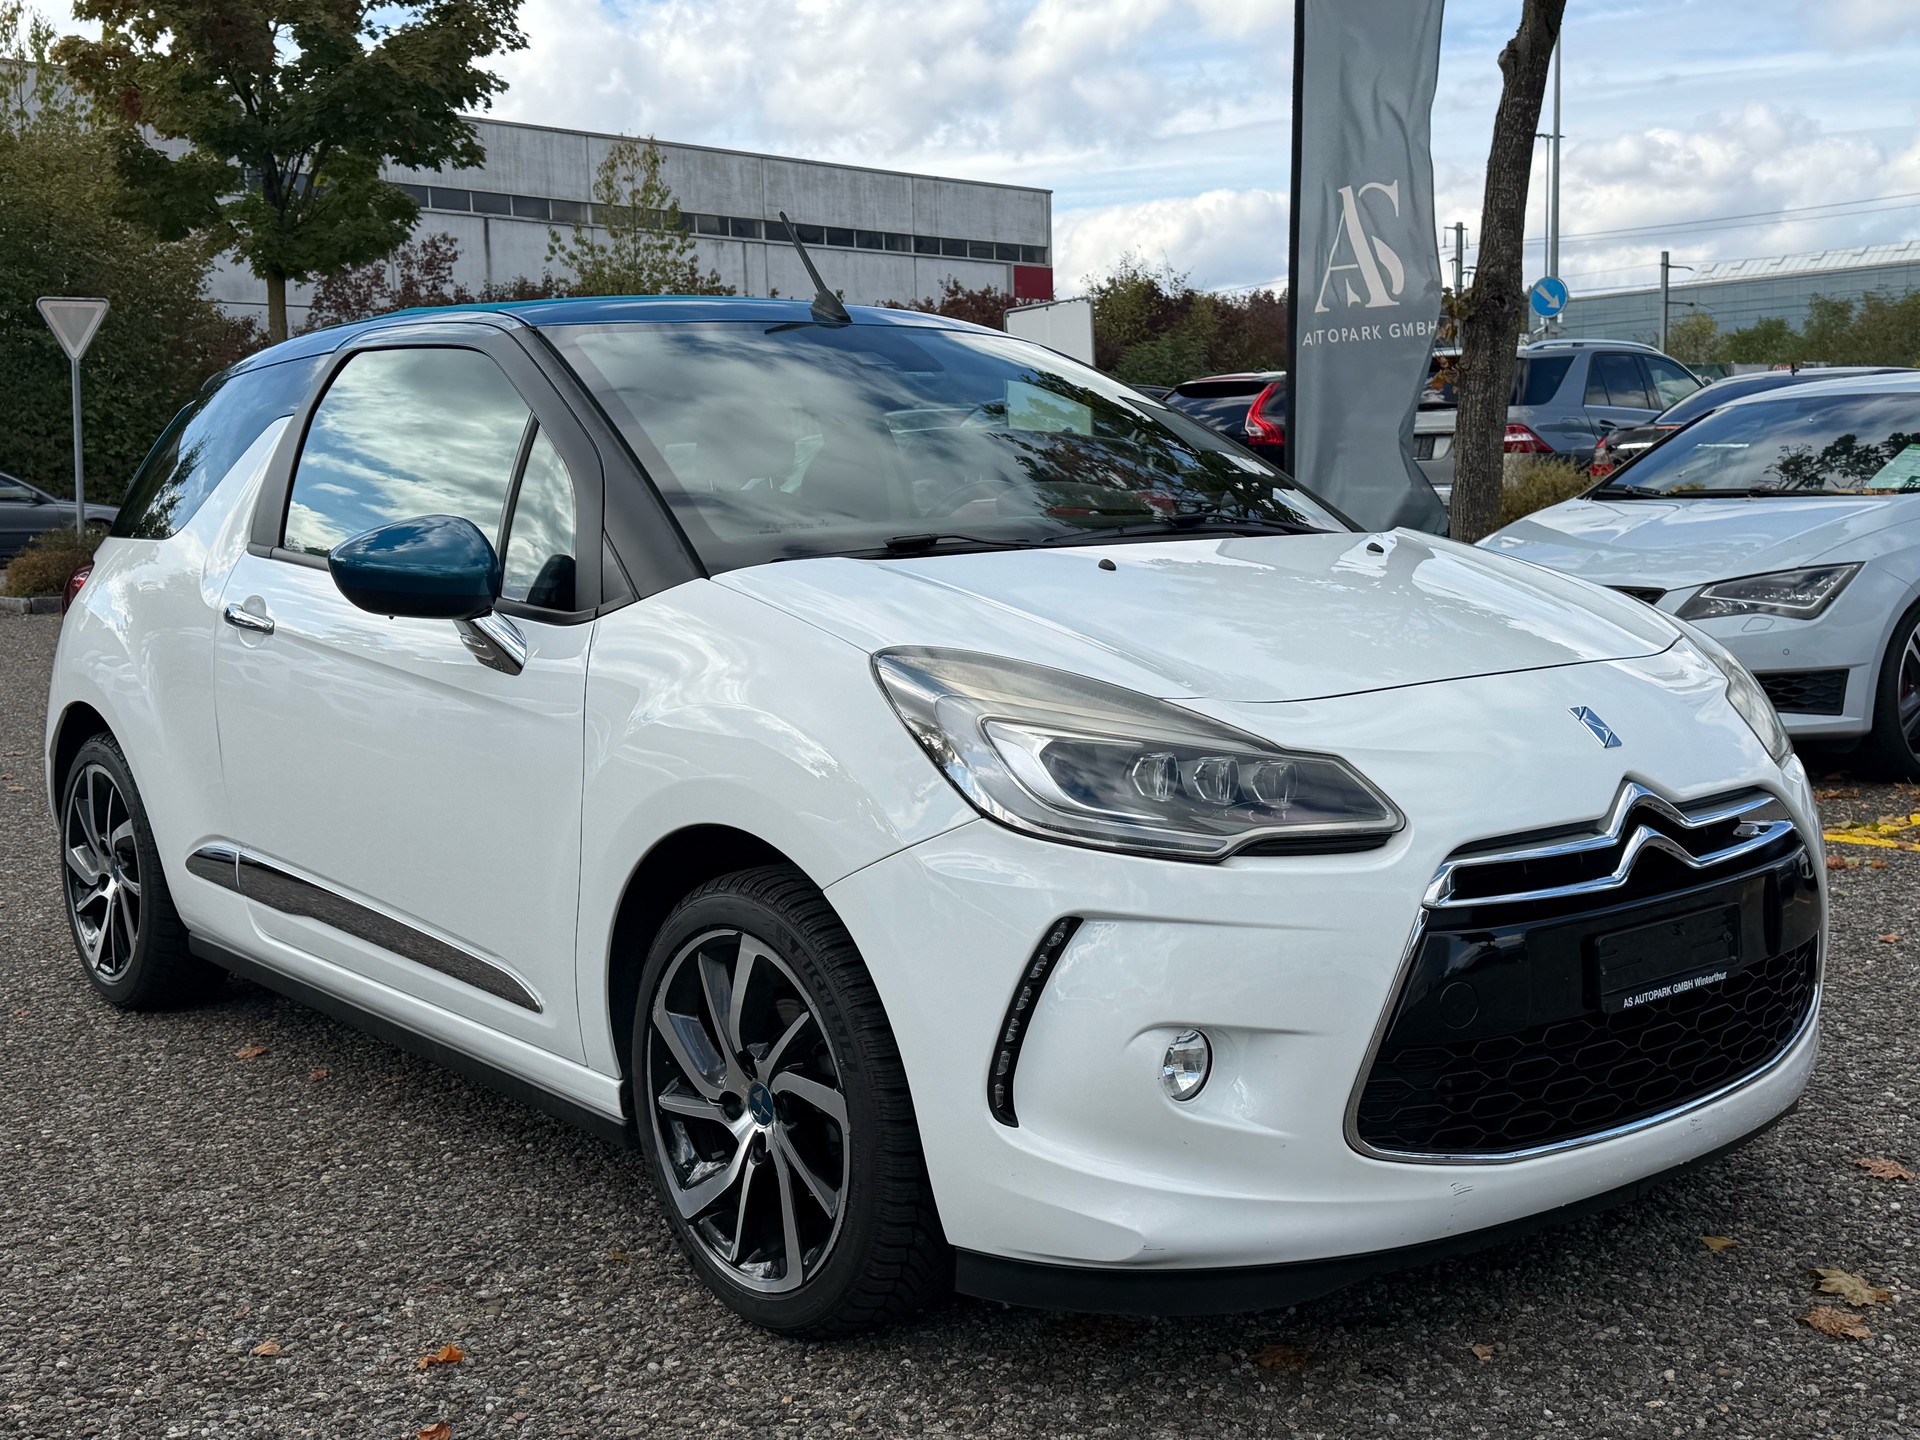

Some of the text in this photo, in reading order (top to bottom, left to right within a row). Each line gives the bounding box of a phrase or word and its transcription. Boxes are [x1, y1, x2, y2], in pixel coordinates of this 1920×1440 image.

[1314, 180, 1405, 313] AS
[1389, 321, 1437, 338] GMBH
[793, 948, 858, 1067] MICHELIN
[1623, 971, 1728, 1008] AS AUTOPARK GMBH Winterthur
